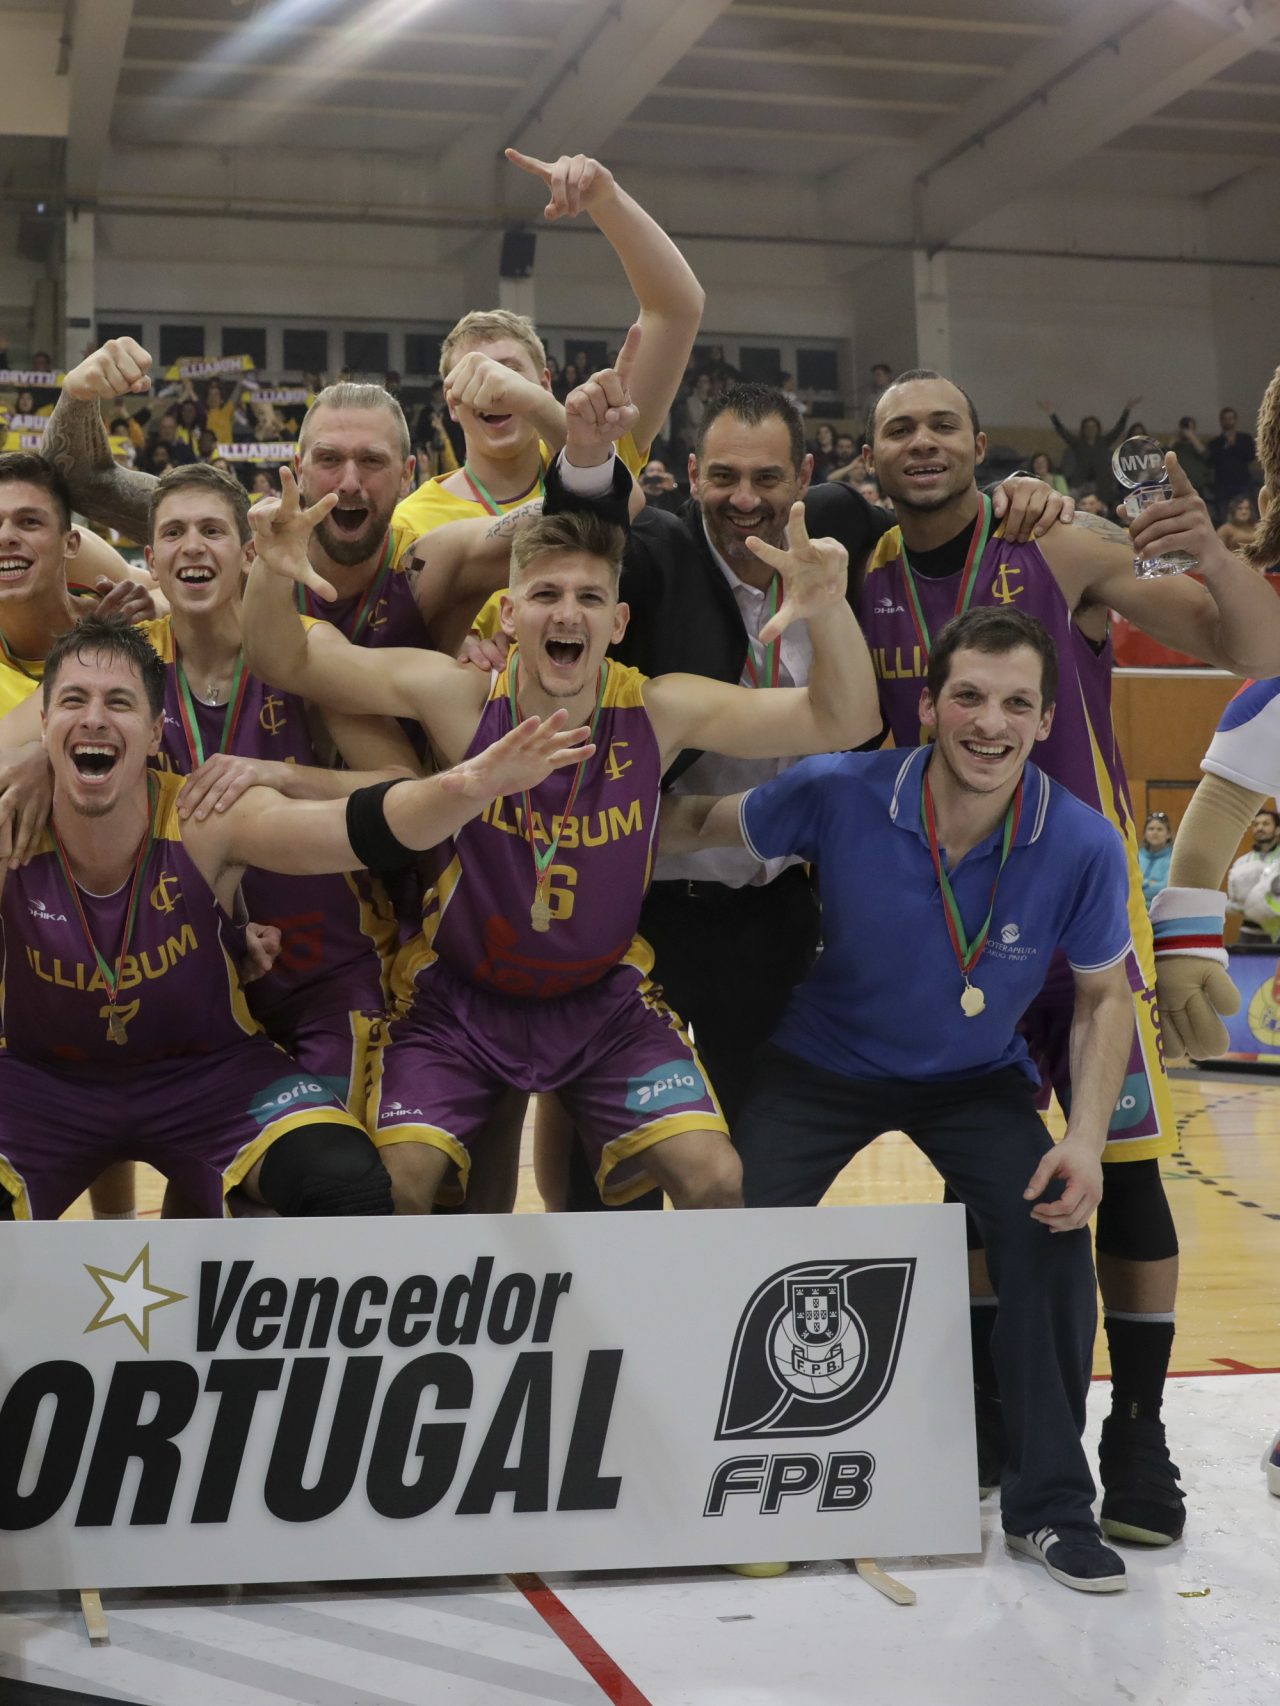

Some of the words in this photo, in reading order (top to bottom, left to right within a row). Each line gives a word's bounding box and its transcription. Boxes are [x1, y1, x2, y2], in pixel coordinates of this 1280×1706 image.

[1120, 453, 1161, 472] MVP
[25, 923, 199, 992] ILLIABUM
[653, 1073, 695, 1097] prio
[195, 1255, 574, 1353] Vencedor
[702, 1450, 877, 1518] FPB
